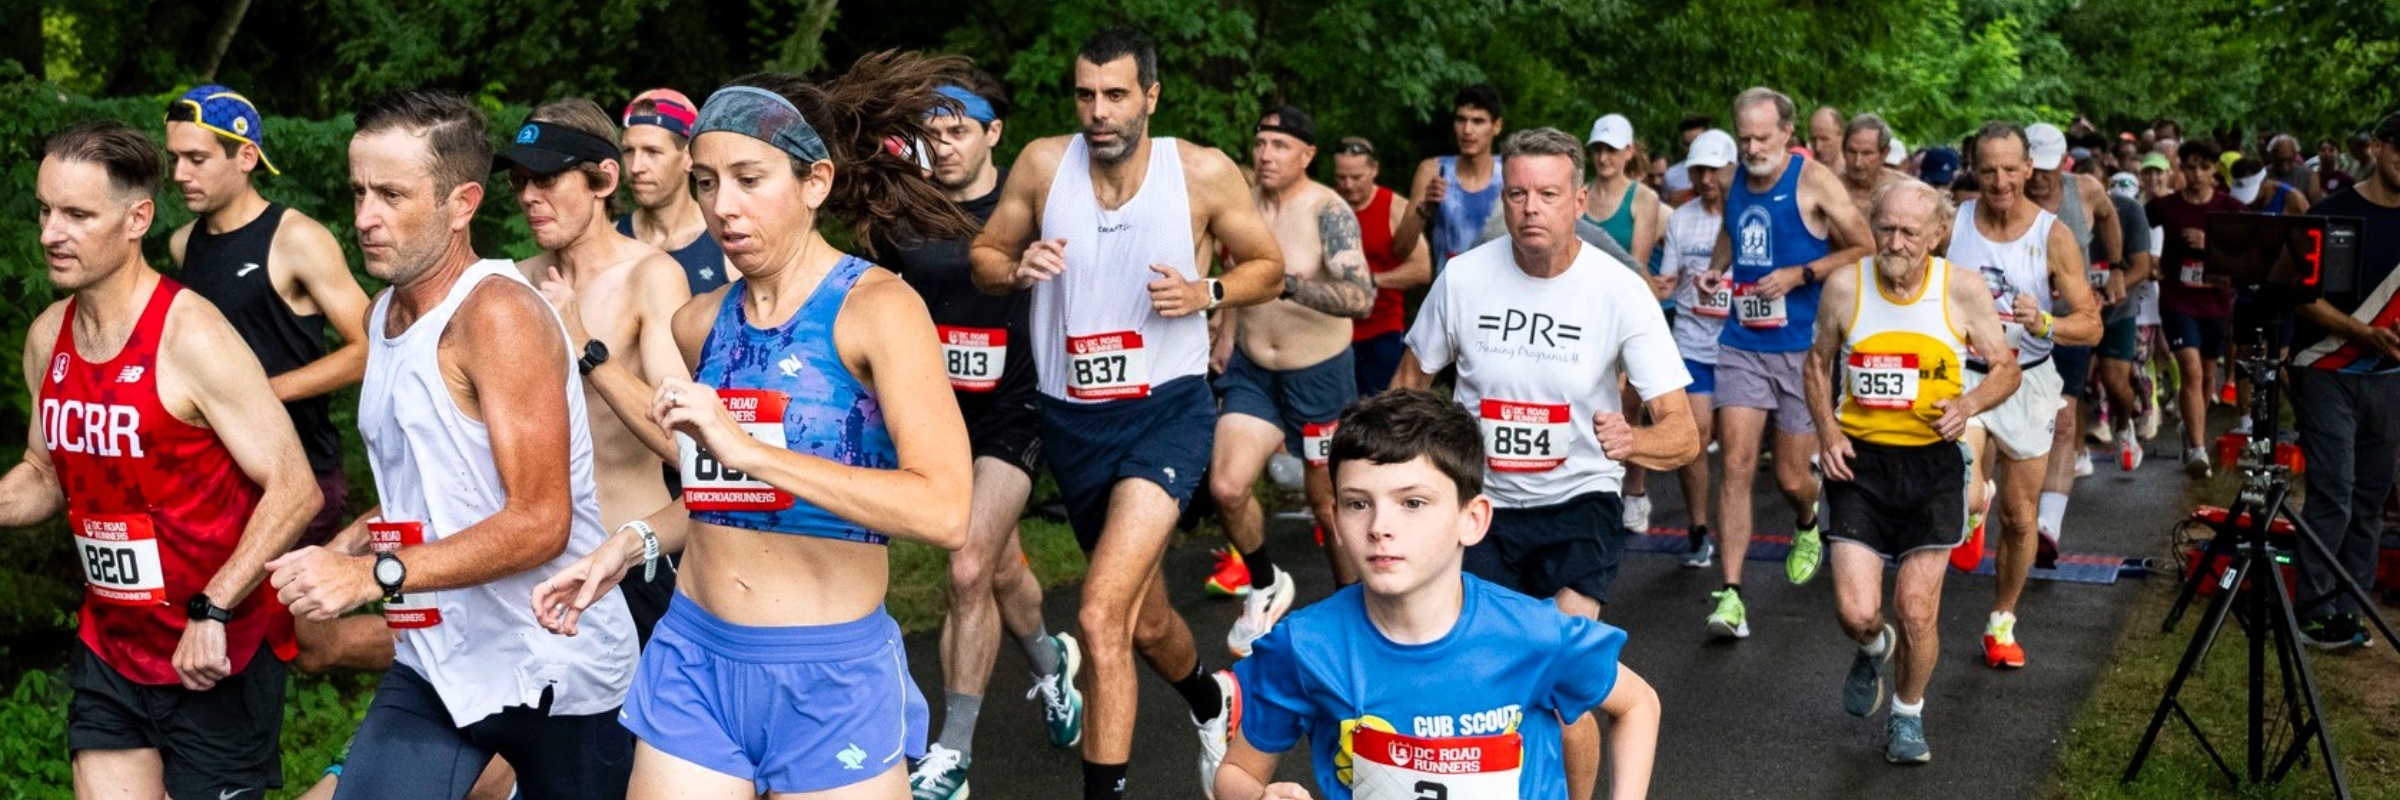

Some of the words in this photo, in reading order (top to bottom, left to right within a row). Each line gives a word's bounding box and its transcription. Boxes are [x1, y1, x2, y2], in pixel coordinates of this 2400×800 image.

[2303, 228, 2322, 286] 3
[1743, 299, 1771, 318] 316
[948, 350, 988, 376] 813
[1074, 355, 1126, 385] 837
[1859, 372, 1904, 395] 353
[729, 397, 758, 410] ROAD
[730, 410, 756, 422] NERS
[1494, 425, 1550, 455] 854
[86, 544, 140, 585] 820
[1413, 715, 1454, 738] CUB
[1414, 747, 1435, 760] DC
[1439, 747, 1481, 761] ROAD
[1414, 759, 1481, 773] RUNNERS
